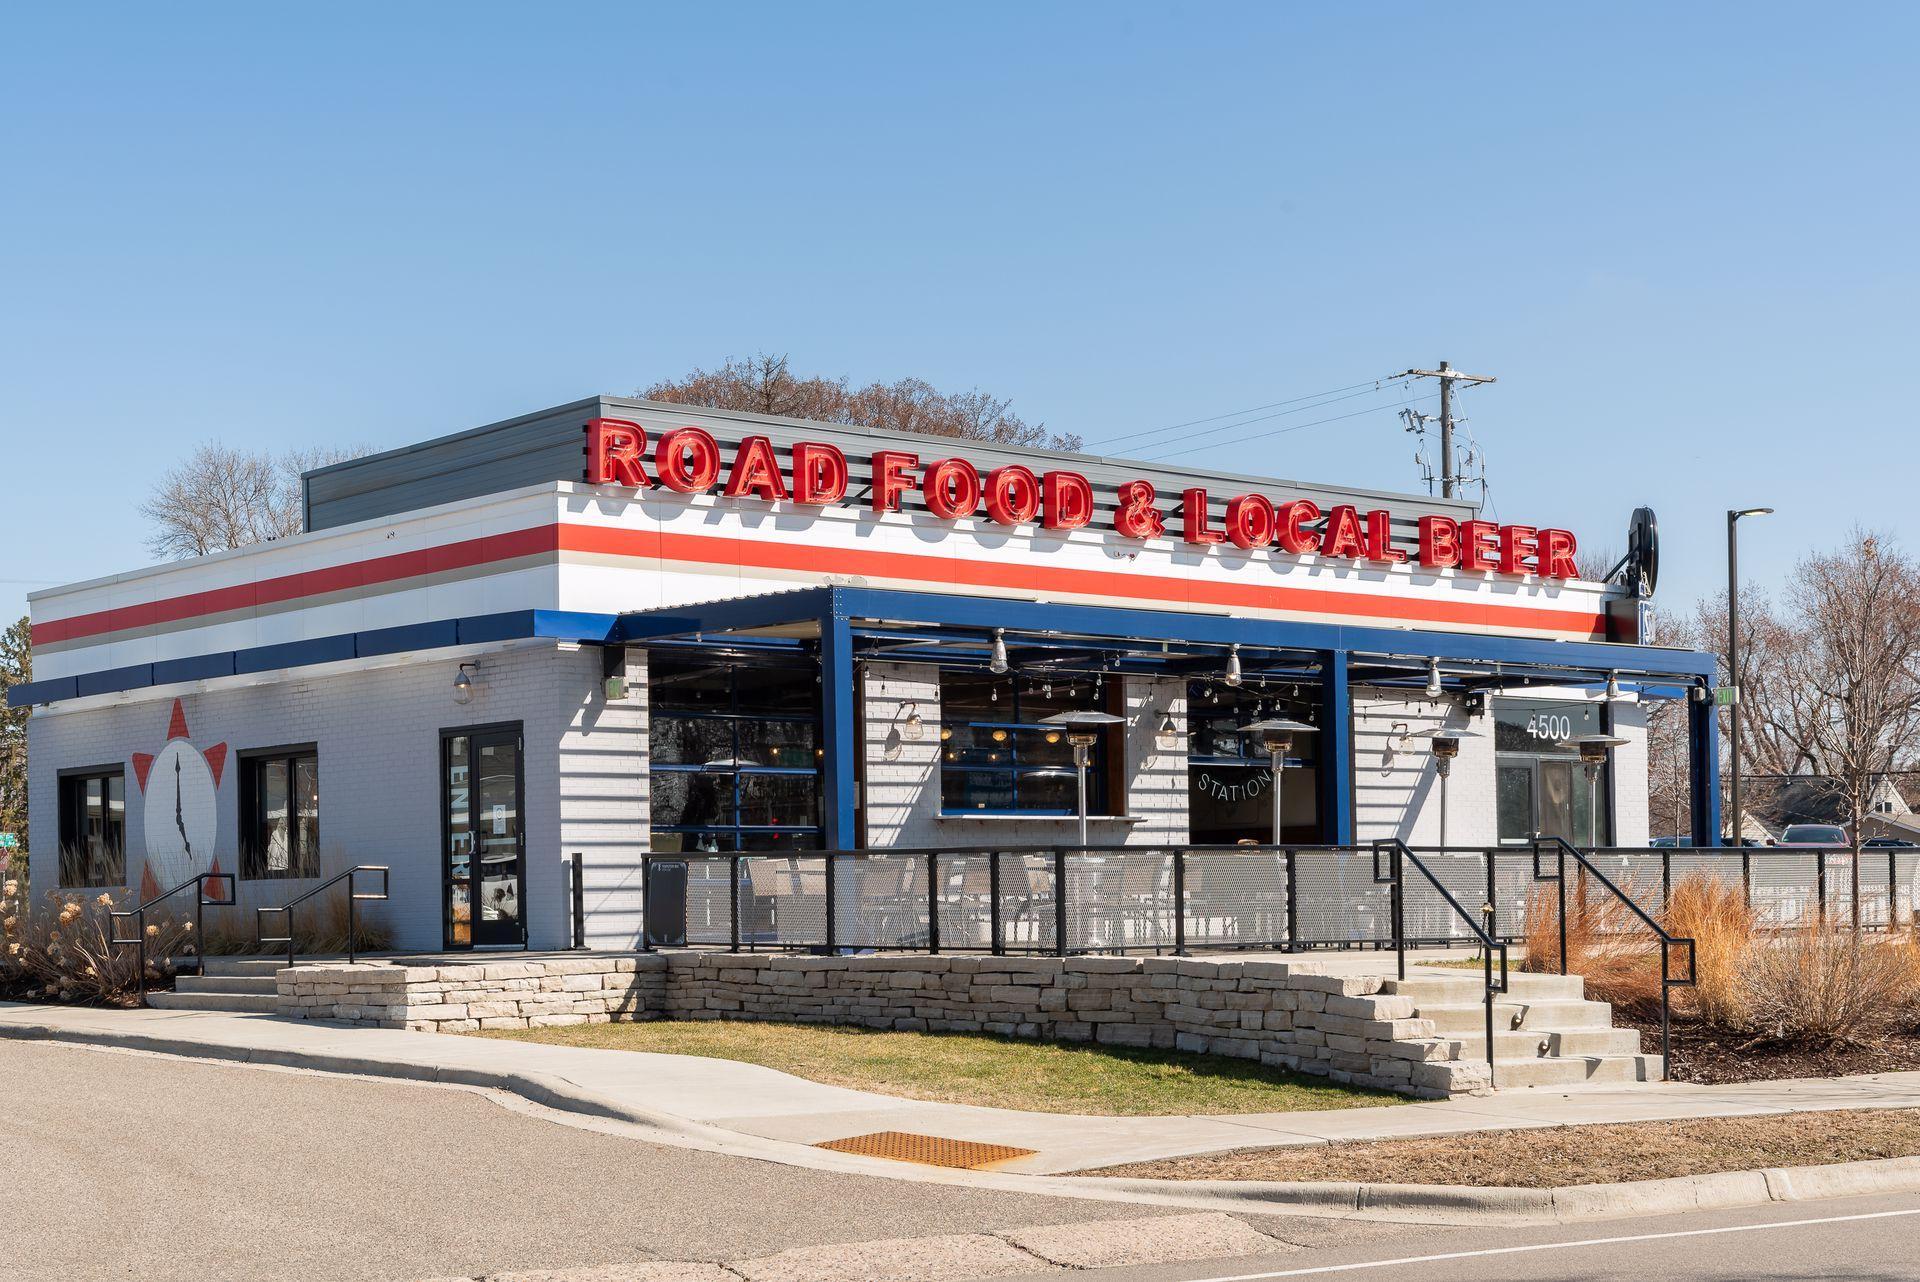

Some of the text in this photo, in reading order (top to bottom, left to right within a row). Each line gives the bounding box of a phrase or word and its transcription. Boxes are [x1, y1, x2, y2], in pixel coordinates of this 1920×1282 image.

[586, 417, 1581, 580] ROAD FOOD & LOCAL BEER
[1717, 688, 1733, 705] EXIT
[1526, 714, 1570, 740] 4500
[1198, 769, 1272, 802] STATION
